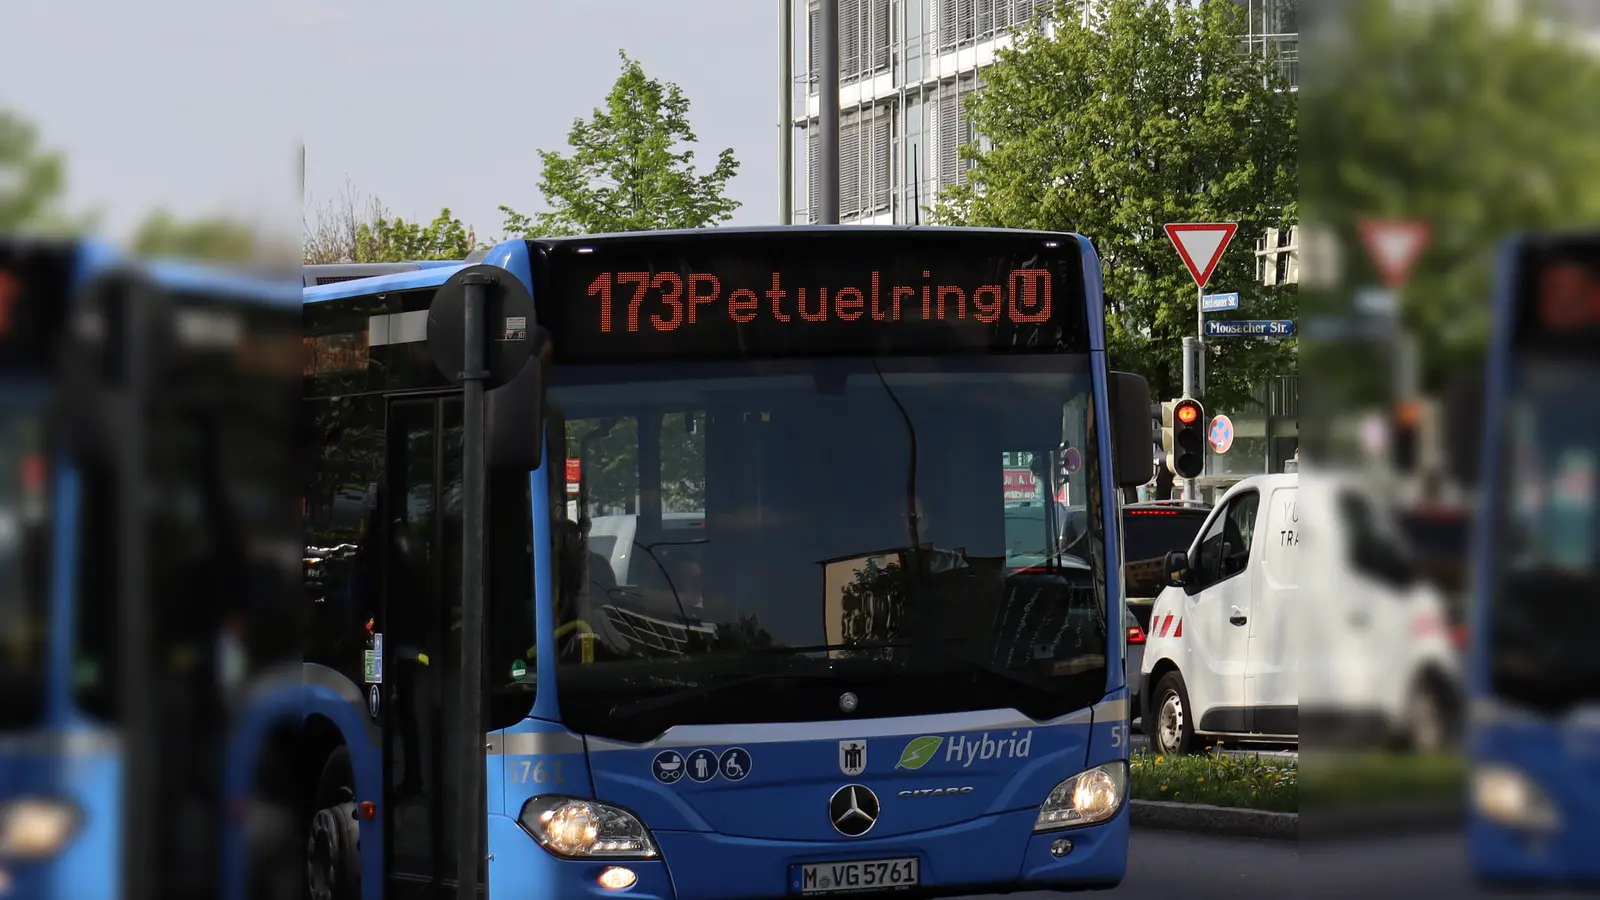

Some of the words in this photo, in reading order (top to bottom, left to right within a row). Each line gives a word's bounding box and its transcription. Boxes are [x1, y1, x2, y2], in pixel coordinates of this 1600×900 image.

[588, 271, 683, 331] 173
[688, 270, 1001, 323] Petuelring
[1210, 322, 1266, 334] Moosacher
[1270, 322, 1289, 333] Str.
[946, 730, 1032, 768] Hybrid
[508, 760, 566, 784] 5761
